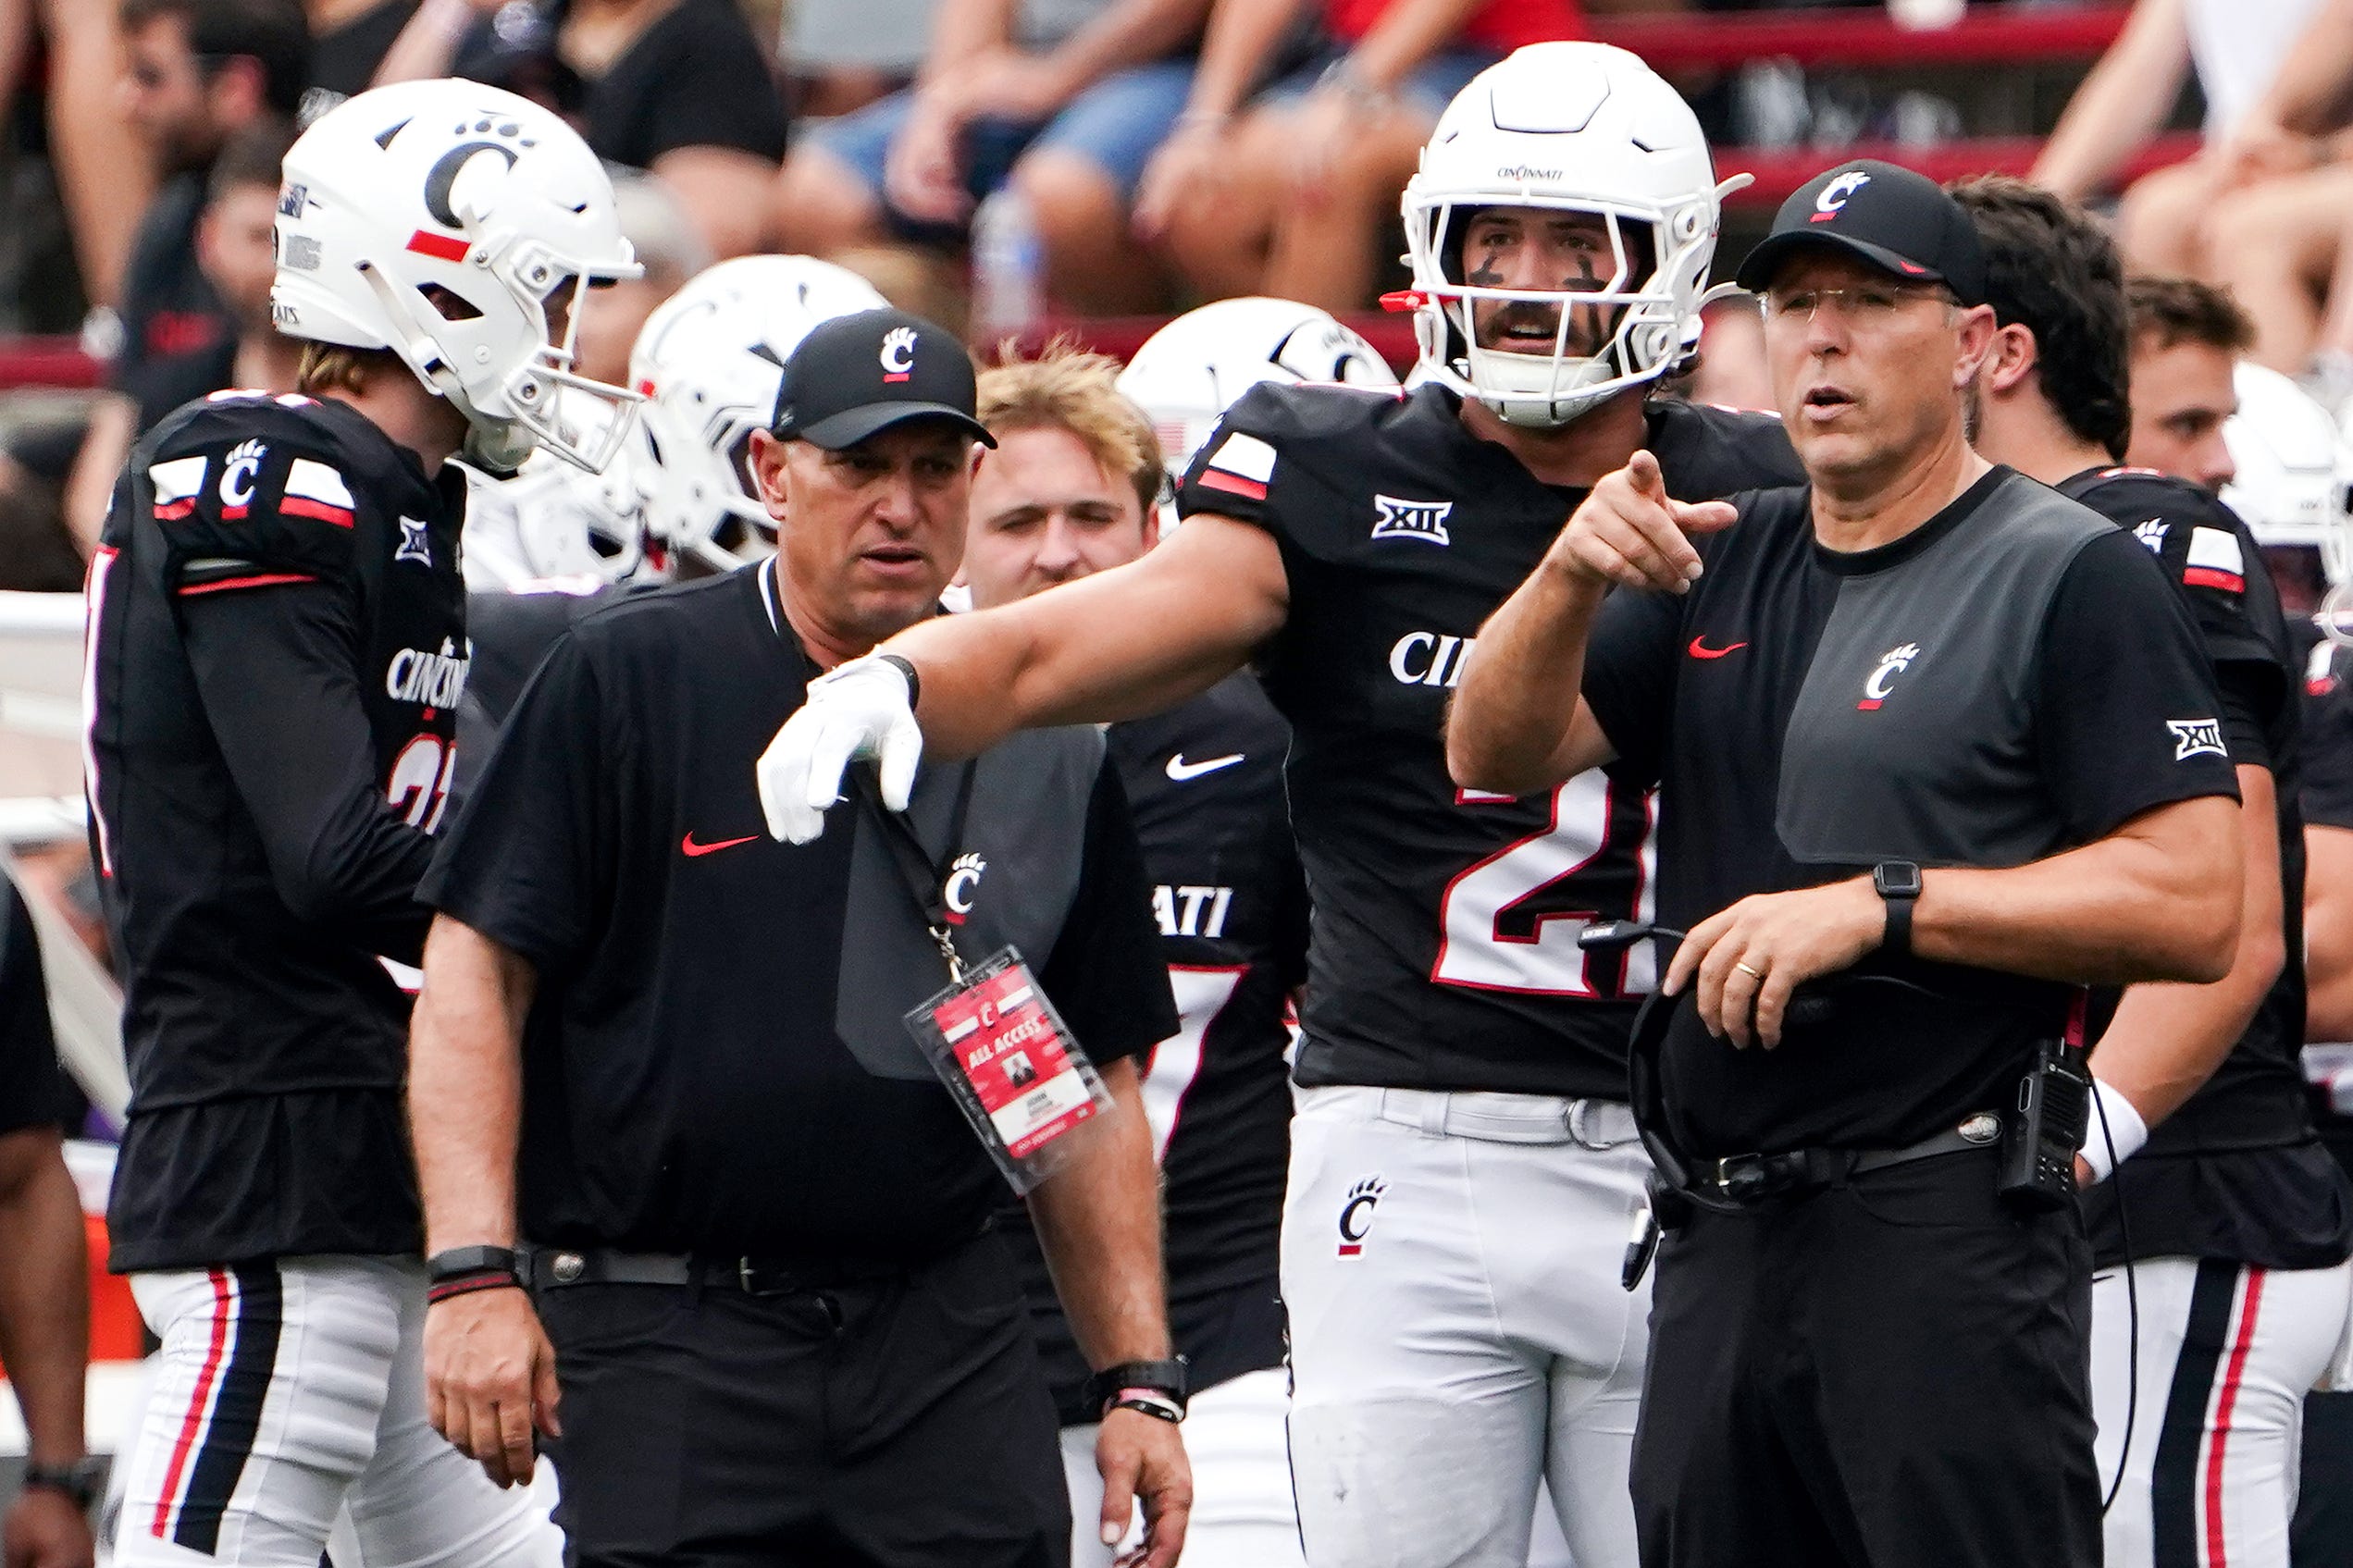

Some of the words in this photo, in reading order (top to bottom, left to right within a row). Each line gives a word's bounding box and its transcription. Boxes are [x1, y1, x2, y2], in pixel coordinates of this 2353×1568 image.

[425, 135, 520, 231] C
[1497, 165, 1562, 180] CINCINNATI
[1816, 176, 1861, 214] C
[881, 333, 916, 373] C
[219, 450, 263, 507] C
[1375, 498, 1449, 542] XII
[1866, 651, 1913, 699] C
[2170, 721, 2223, 756] XII
[945, 860, 984, 915] C
[968, 1043, 994, 1069] ALL
[994, 1019, 1044, 1055] ACCESS
[1339, 1188, 1380, 1242] C
